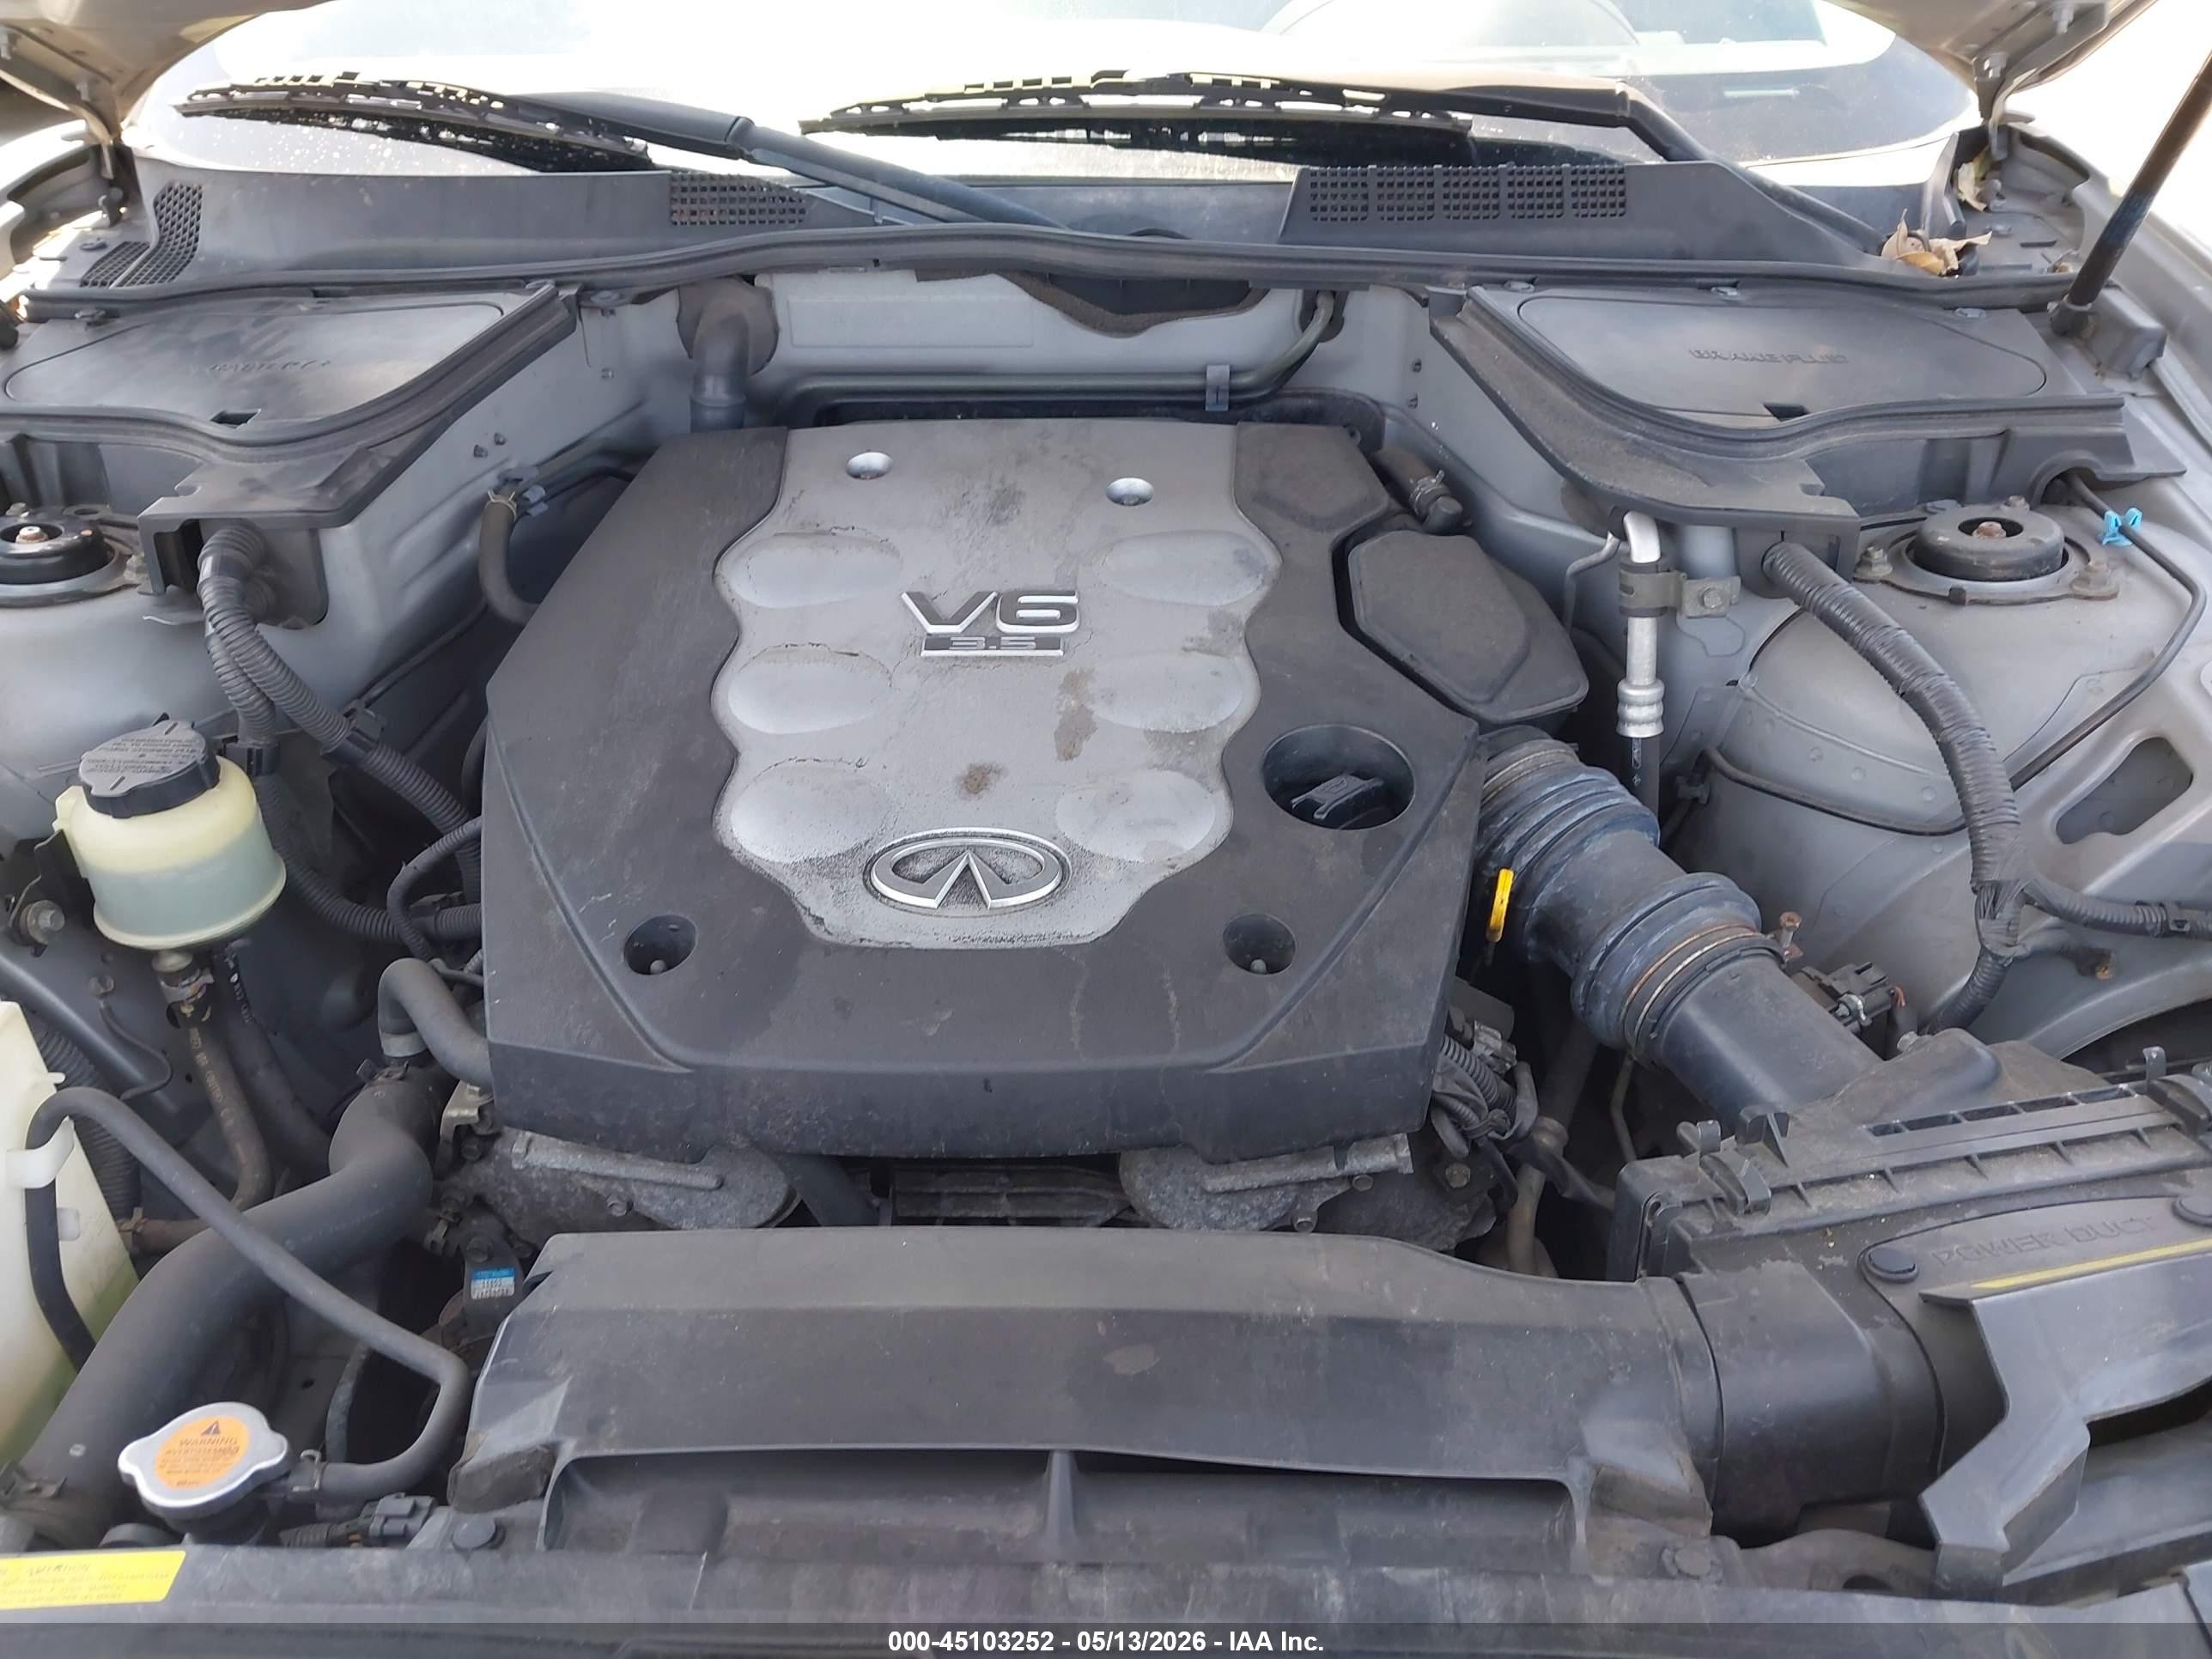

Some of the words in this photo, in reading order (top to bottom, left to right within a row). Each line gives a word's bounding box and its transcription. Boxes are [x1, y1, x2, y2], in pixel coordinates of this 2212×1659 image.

[902, 590, 1079, 634] V6
[948, 635, 1037, 650] 3.5
[1932, 1233, 2063, 1267] POWER
[2063, 1216, 2159, 1243] DUCT
